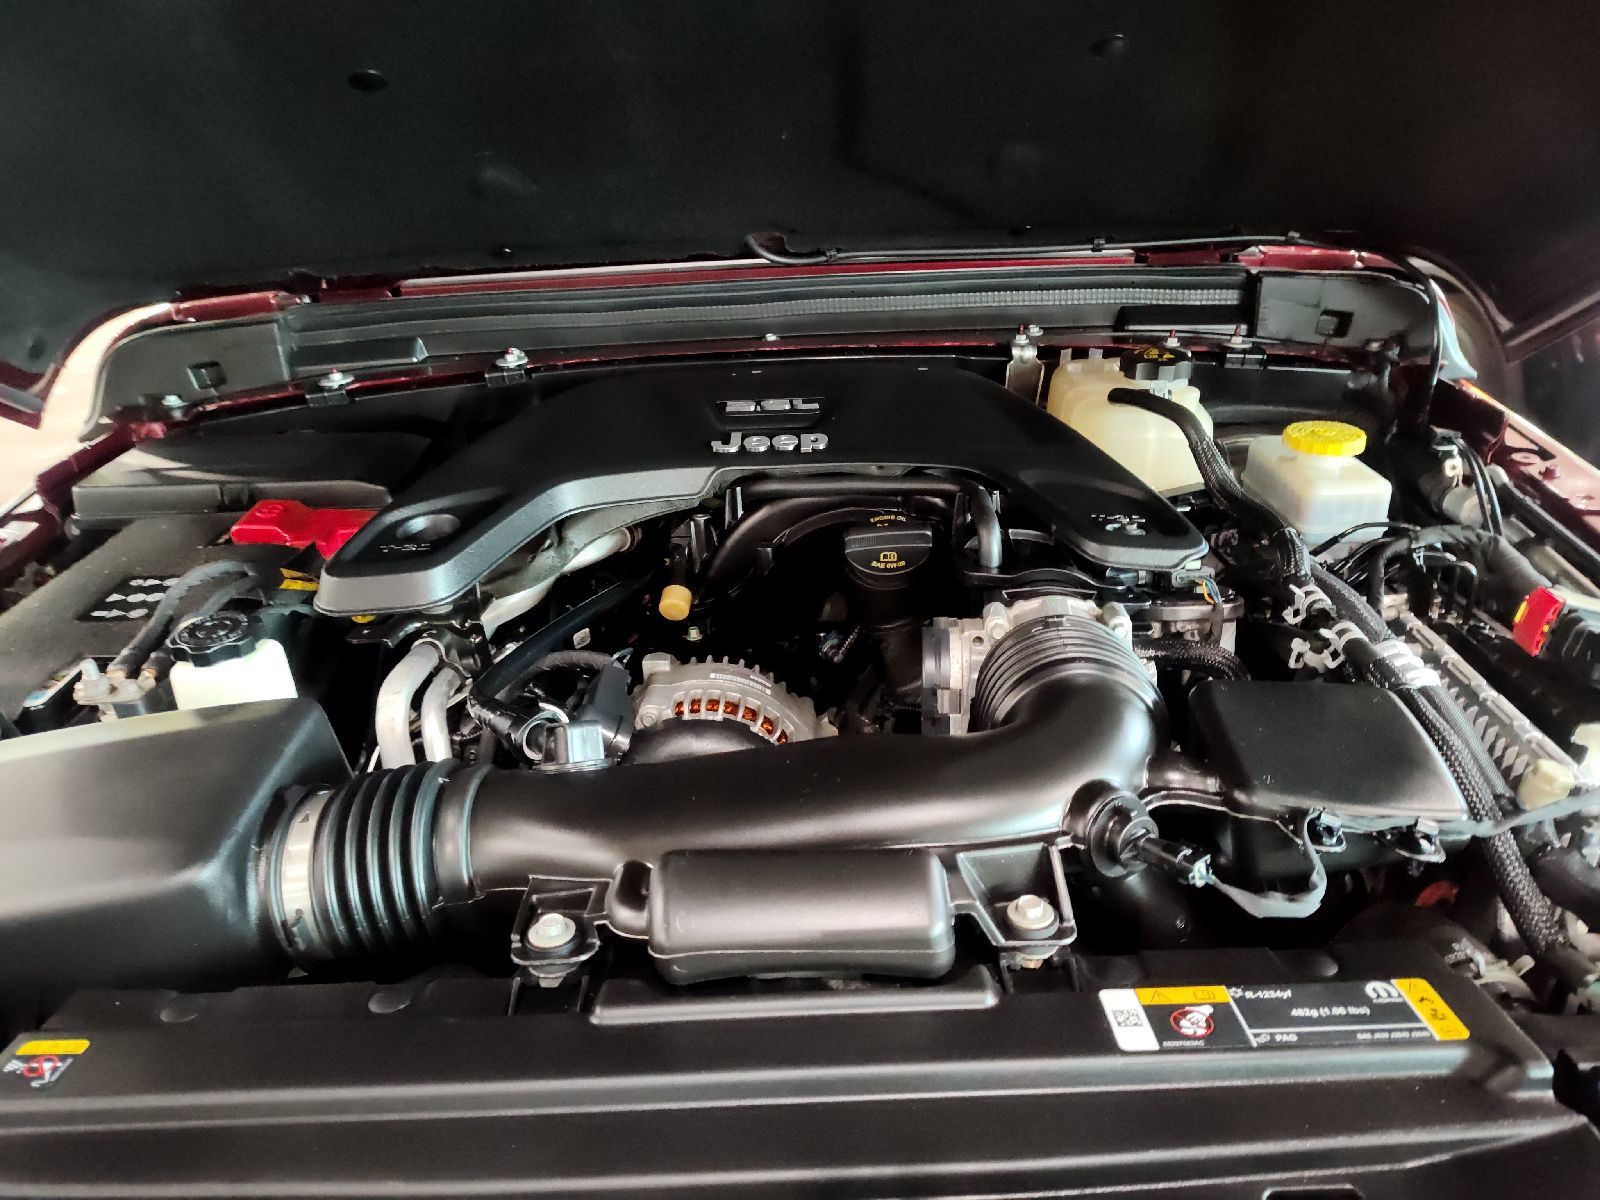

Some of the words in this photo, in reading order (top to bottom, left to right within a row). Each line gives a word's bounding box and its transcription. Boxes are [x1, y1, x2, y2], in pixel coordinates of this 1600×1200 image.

[711, 432, 829, 453] Jeep
[869, 515, 896, 523] ENGINE
[871, 561, 886, 569] SAE
